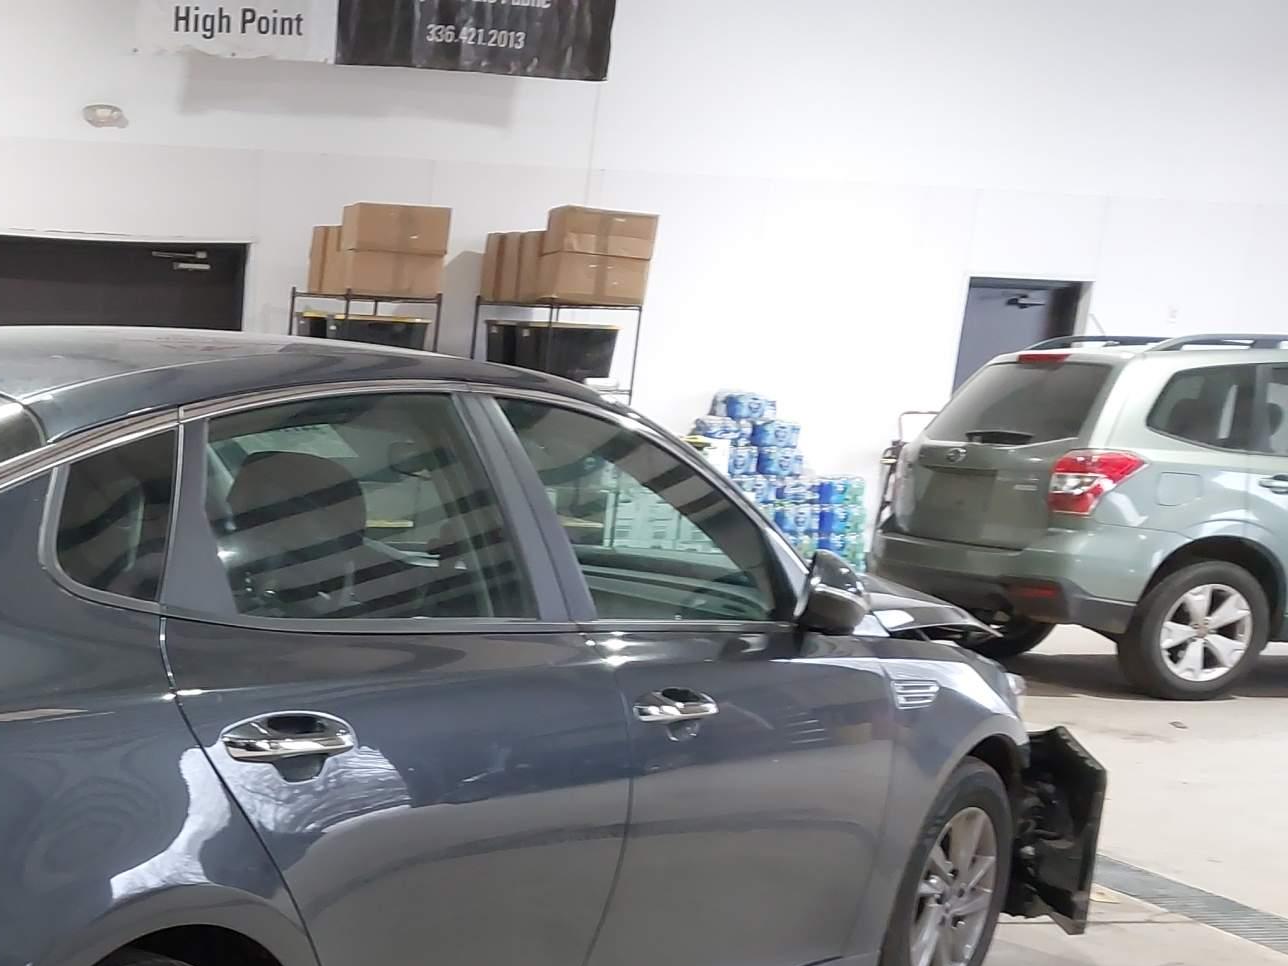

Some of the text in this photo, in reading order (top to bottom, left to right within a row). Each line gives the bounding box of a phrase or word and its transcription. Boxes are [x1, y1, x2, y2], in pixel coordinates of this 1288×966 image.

[173, 5, 304, 40] High Point
[426, 23, 526, 49] 336.421.2013
